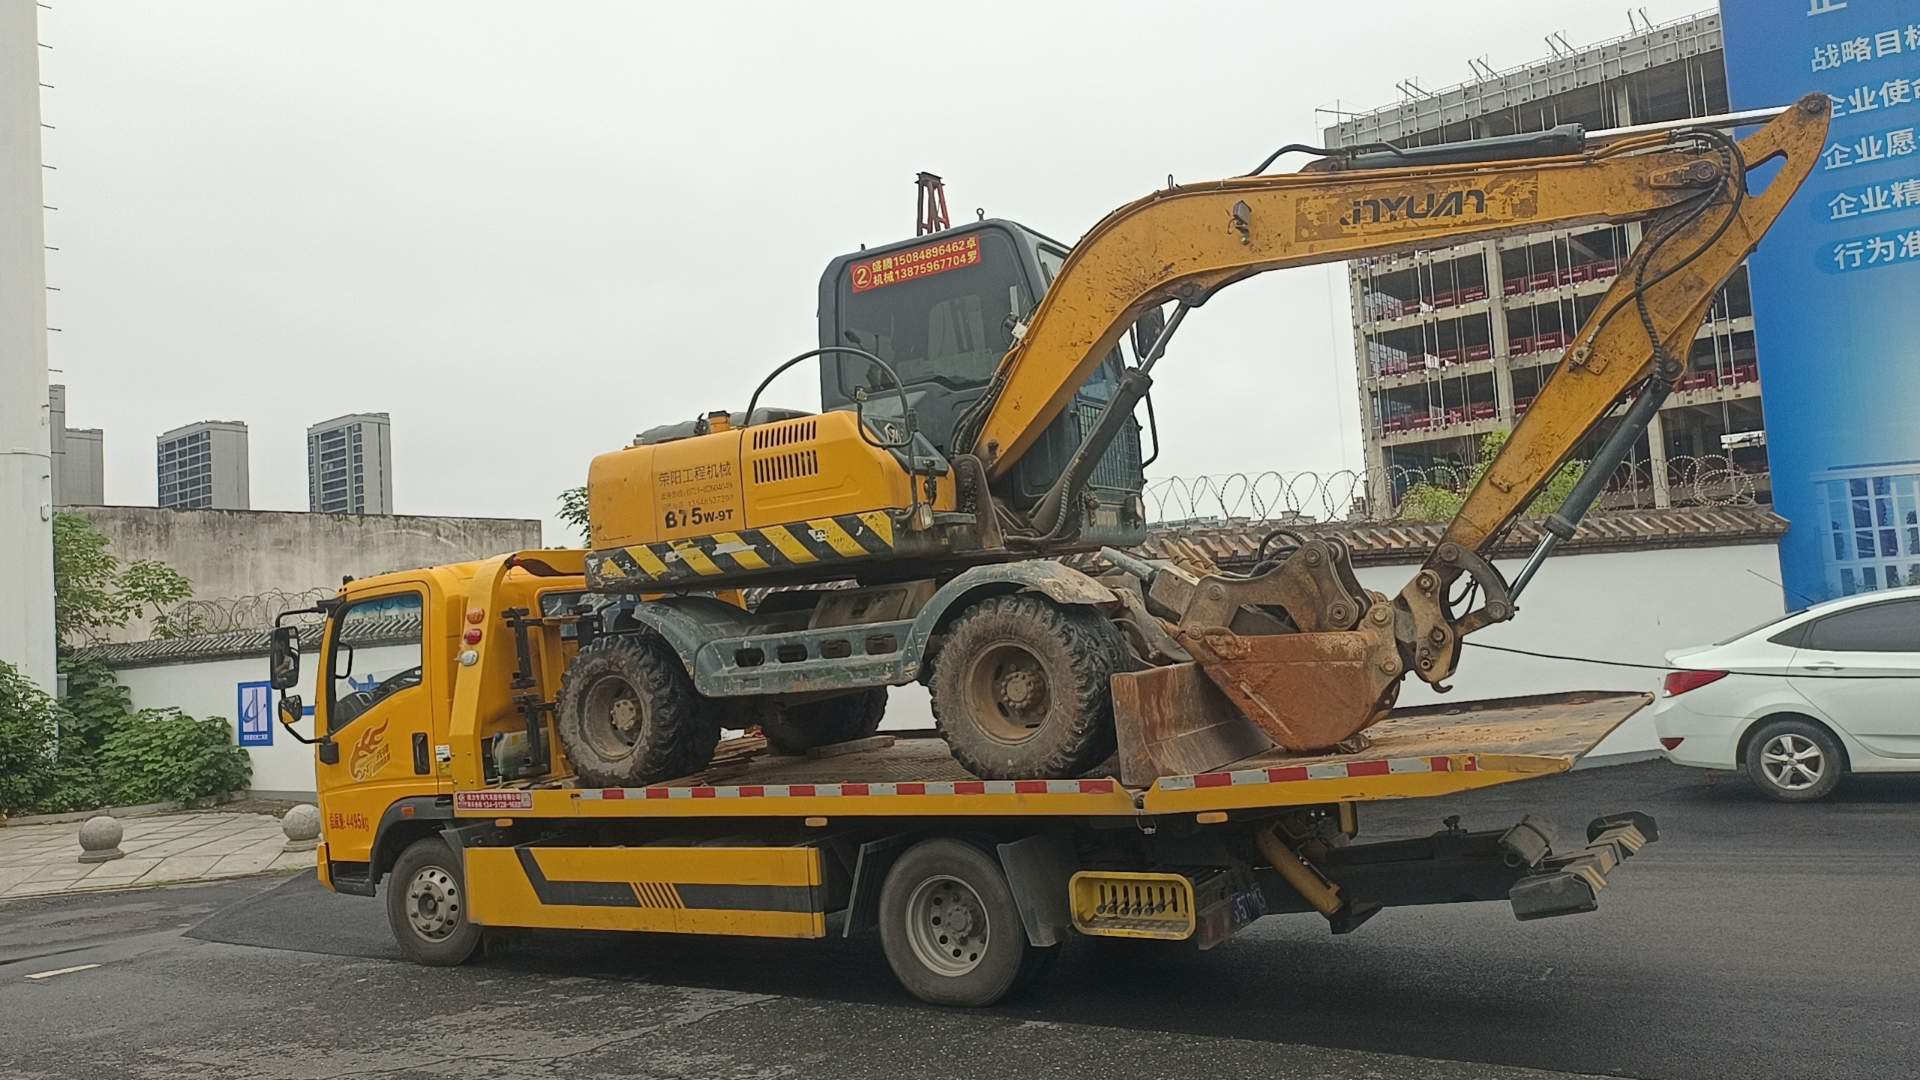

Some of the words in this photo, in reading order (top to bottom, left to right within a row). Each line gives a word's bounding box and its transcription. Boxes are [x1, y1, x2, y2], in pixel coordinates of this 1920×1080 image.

[1822, 127, 1920, 170] 企业愿
[1828, 178, 1920, 220] 企业精
[1833, 230, 1920, 270] 行为准
